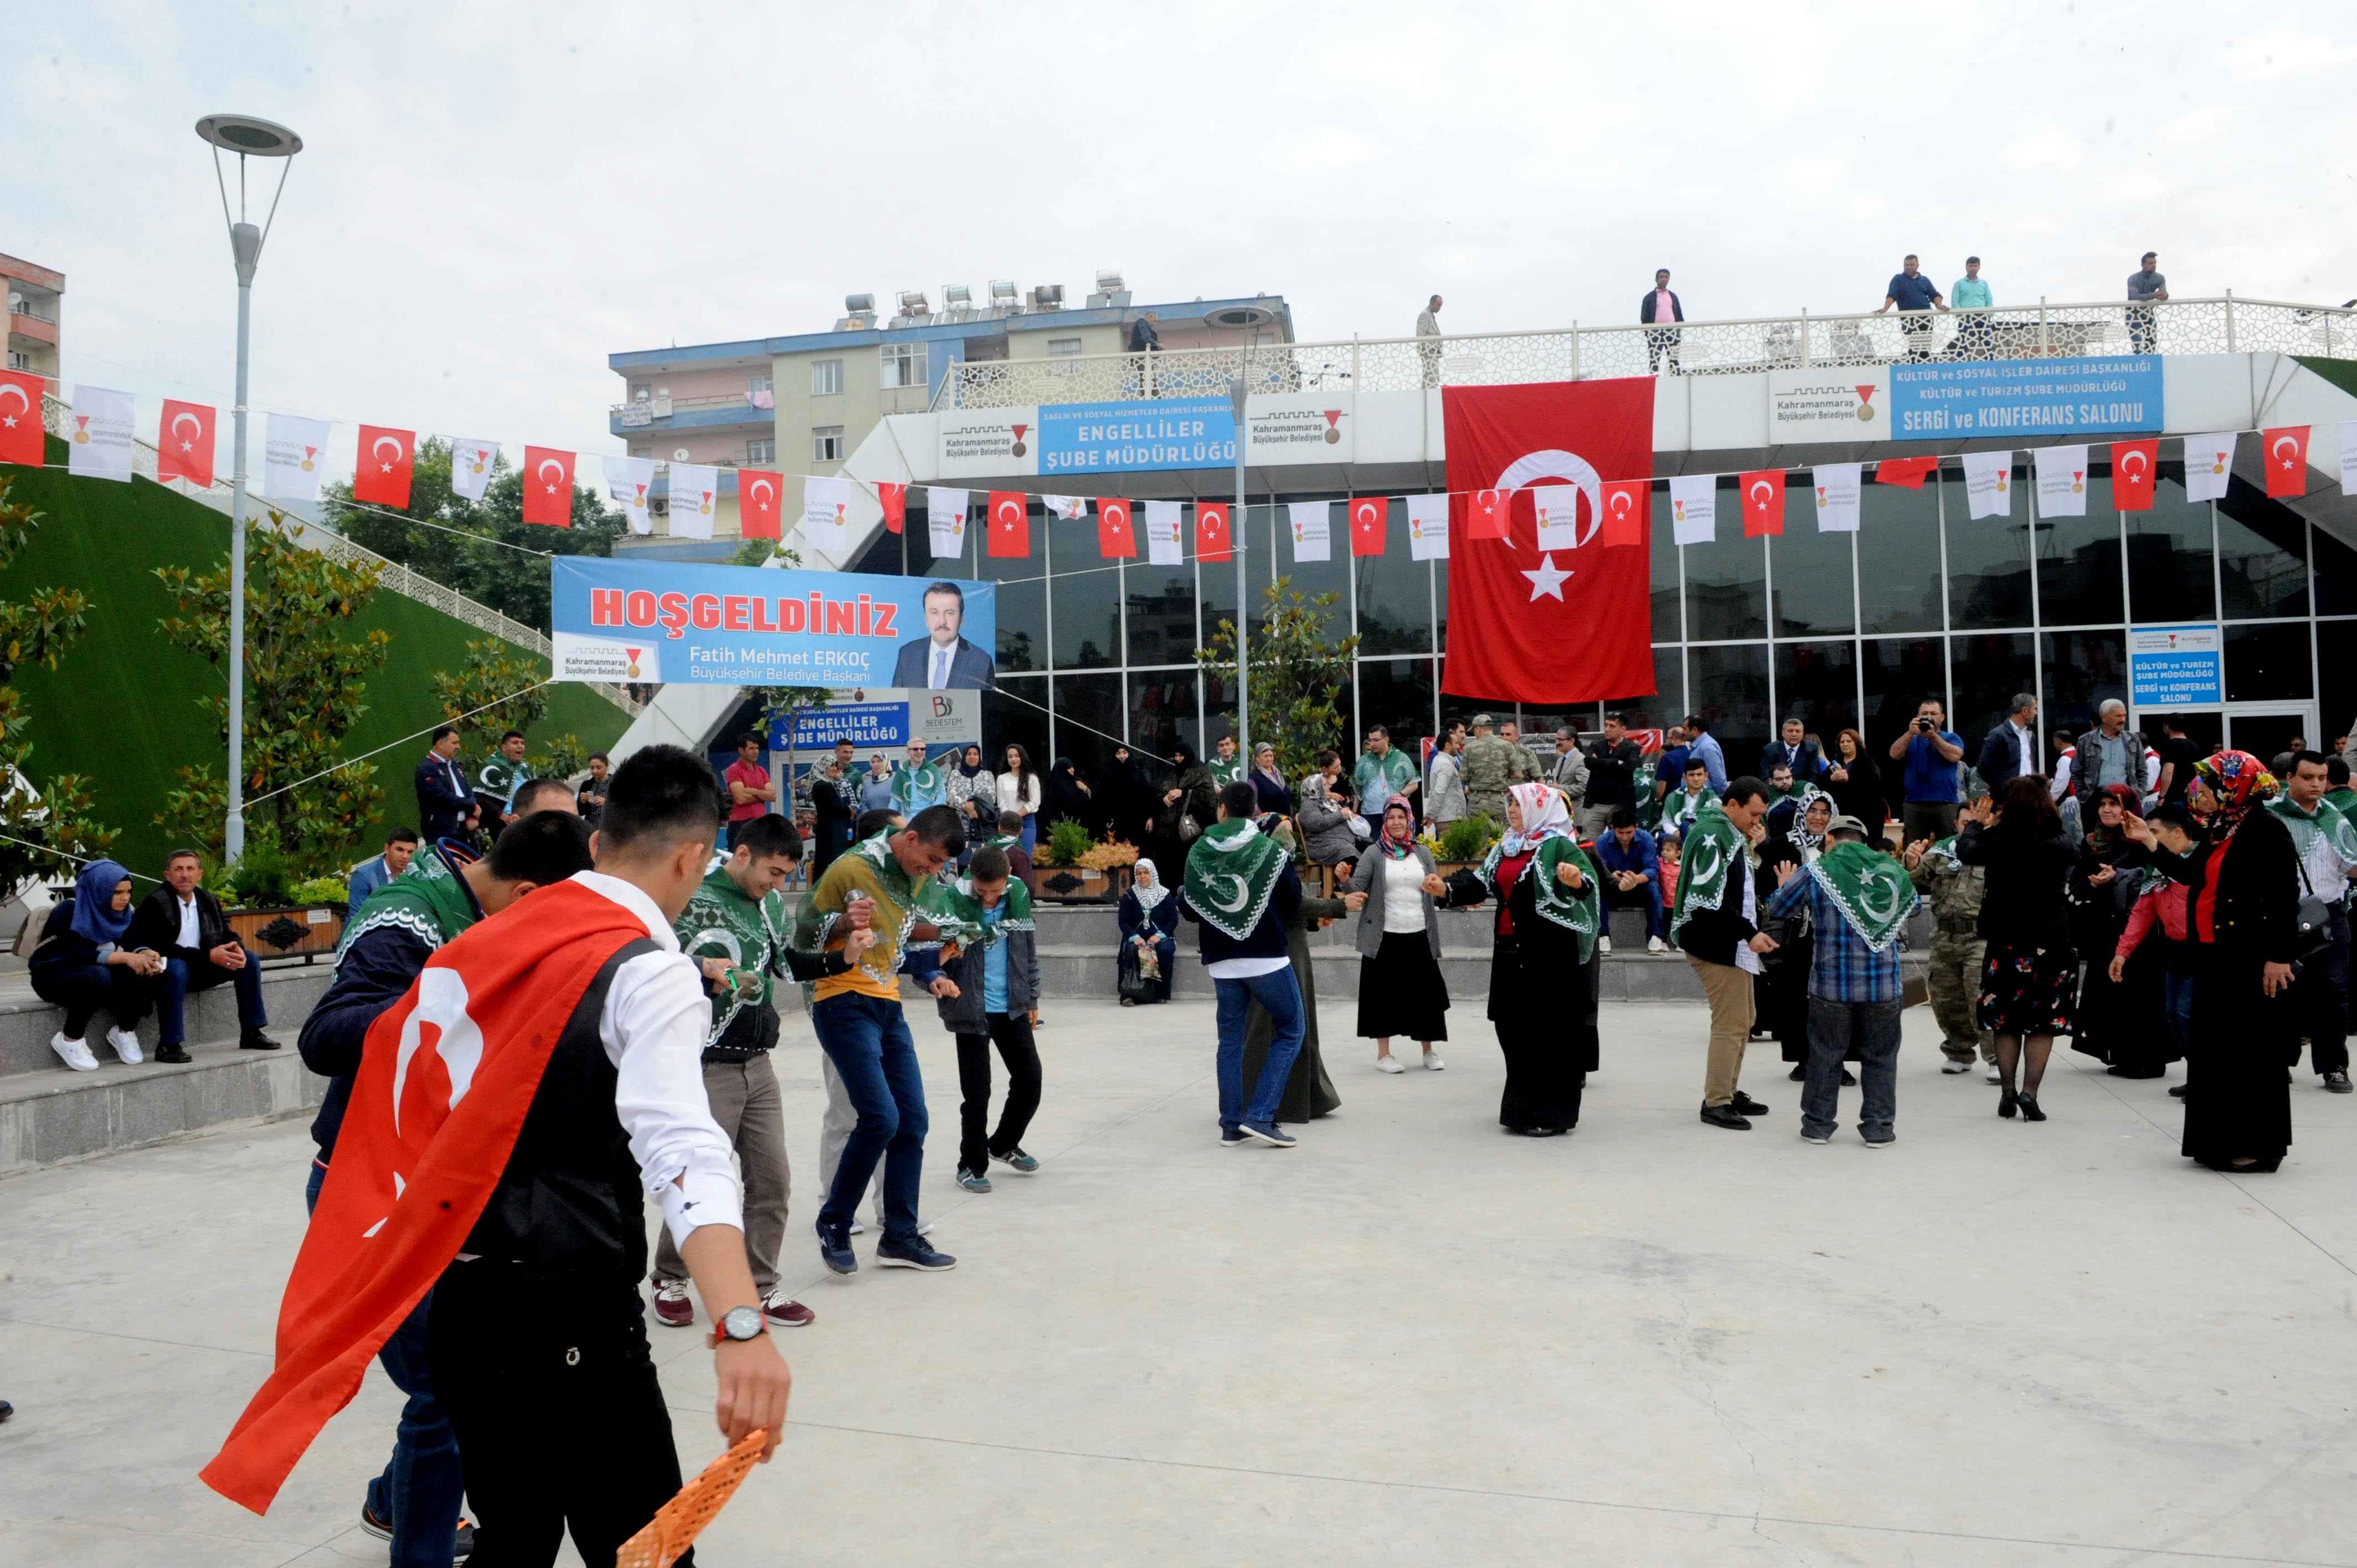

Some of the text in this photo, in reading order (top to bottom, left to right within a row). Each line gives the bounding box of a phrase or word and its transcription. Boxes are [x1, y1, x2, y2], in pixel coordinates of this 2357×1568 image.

[1897, 370, 1938, 381] KÜLTÜR
[1942, 372, 1953, 380] ve
[1957, 368, 1998, 379] SOSYAL
[2036, 363, 2080, 376] DAİRESİ
[2083, 360, 2150, 375] BAŞKANLIĞI
[1920, 386, 1962, 399] KÜLTÜR
[1980, 385, 2021, 396] TURİZM
[2025, 385, 2053, 396] ŞUBE
[2056, 380, 2127, 394] MÜDÜRLÜĞÜ
[1778, 400, 1854, 409] Kahramanmaraş
[1044, 411, 1071, 420] SAĞLIK
[1084, 410, 1113, 419] SOSYAL
[1115, 408, 1157, 417] HİZMETLER
[1160, 406, 1191, 415] DAİRESİ
[1192, 405, 1235, 414] BAŞKANLI
[1778, 410, 1855, 422] Büyükşehir Belediyesi
[1903, 403, 2143, 430] SERGİ ve KONFERANS SALONU
[1079, 419, 1205, 442] ENGELLİLER
[1253, 424, 1322, 433] Kahramanmaraş
[946, 439, 1010, 447] Kahramanmaraş
[1253, 433, 1322, 445] Büyükşehir Belediyesi
[946, 447, 1010, 458] Büyükşehir Belediyesi
[1047, 441, 1236, 470] ŞUBE MÜDÜRLÜĞÜ
[591, 588, 897, 639] HOŞGELDİNİZ
[566, 658, 626, 668] Kahramanmaraş
[690, 646, 869, 670] Fatih Mehmet ERKOÇ
[2181, 661, 2214, 669] TURİZM
[565, 667, 626, 676] Büyükşehir Belediyesi
[691, 666, 869, 684] Büyükşehir Belediye Başkanı
[2160, 669, 2214, 679] MÜDÜRLÜĞÜ
[2135, 683, 2158, 693] SERGİ
[2170, 683, 2216, 692] KONFERANS
[2160, 694, 2191, 702] SALONU
[800, 715, 877, 730] ENGELLİLER
[817, 726, 897, 743] MÜDÜRLÜĞÜ
